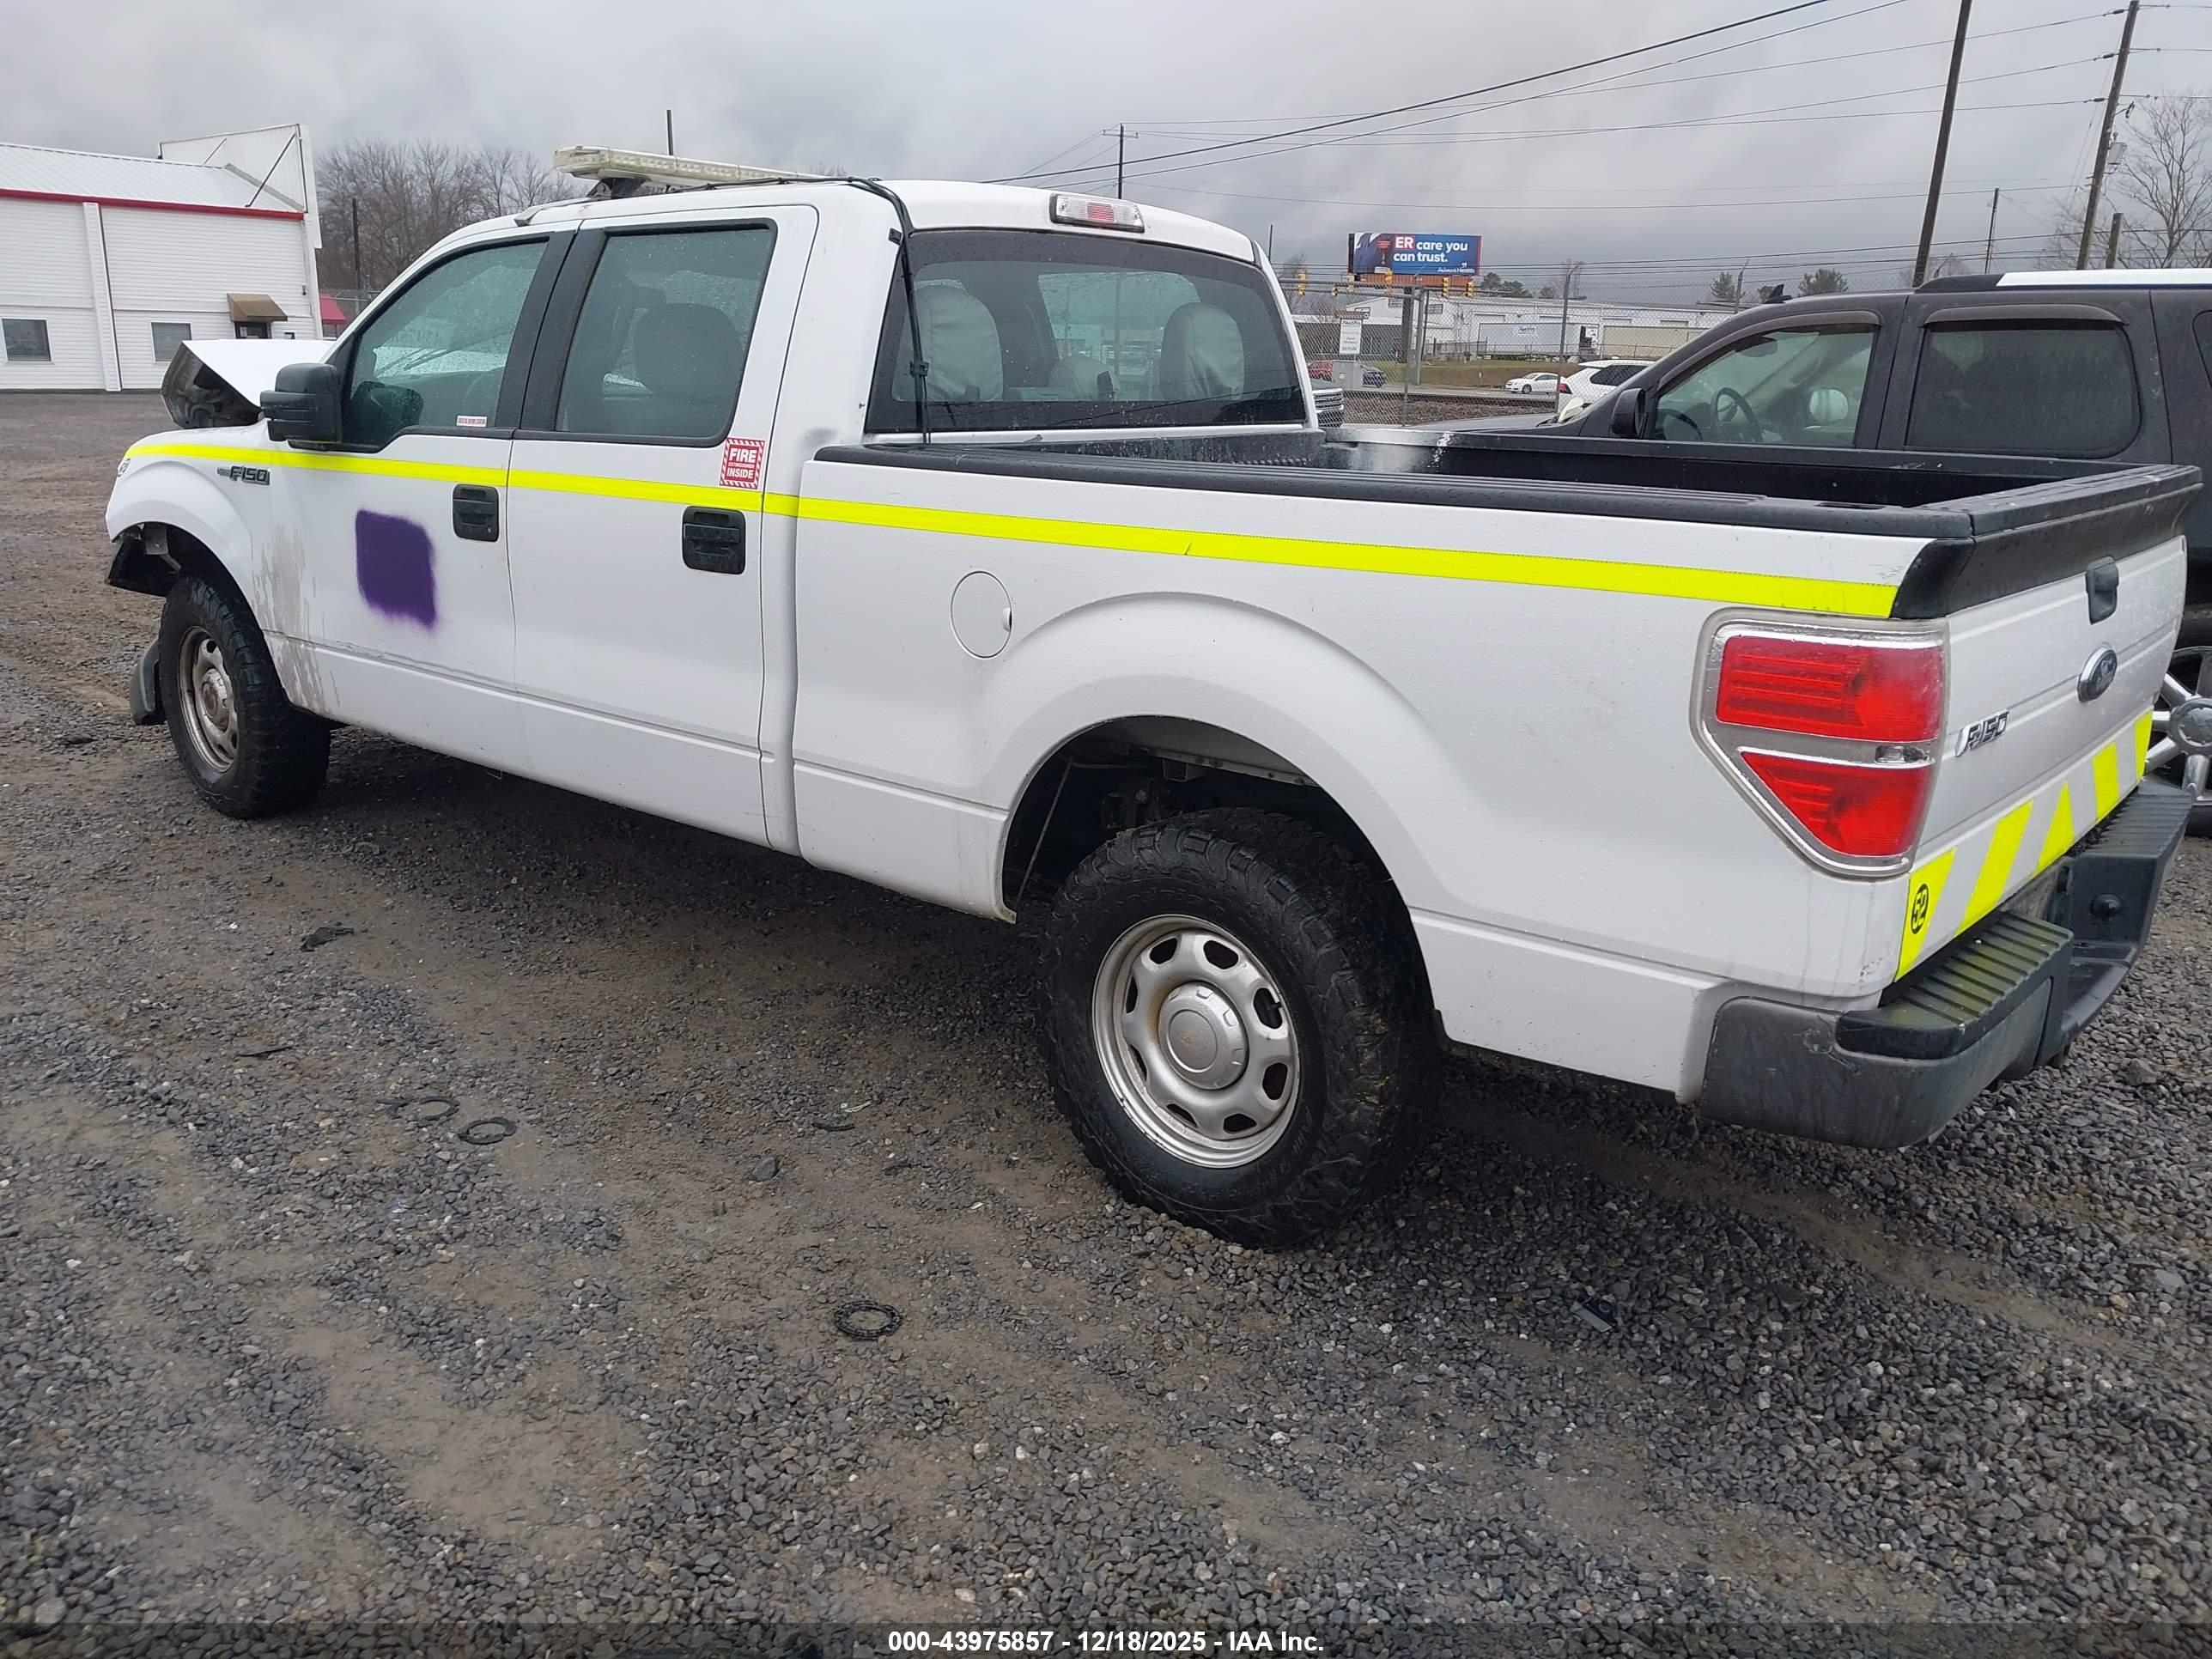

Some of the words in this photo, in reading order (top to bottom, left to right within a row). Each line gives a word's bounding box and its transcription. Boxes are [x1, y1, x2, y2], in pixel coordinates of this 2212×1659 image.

[1395, 236, 1414, 249] ER
[1417, 241, 1443, 251] care
[1445, 242, 1468, 253] you
[1394, 252, 1415, 262] can
[1417, 252, 1448, 263] trust.
[728, 447, 757, 463] FIRE
[726, 467, 754, 479] INSIDE
